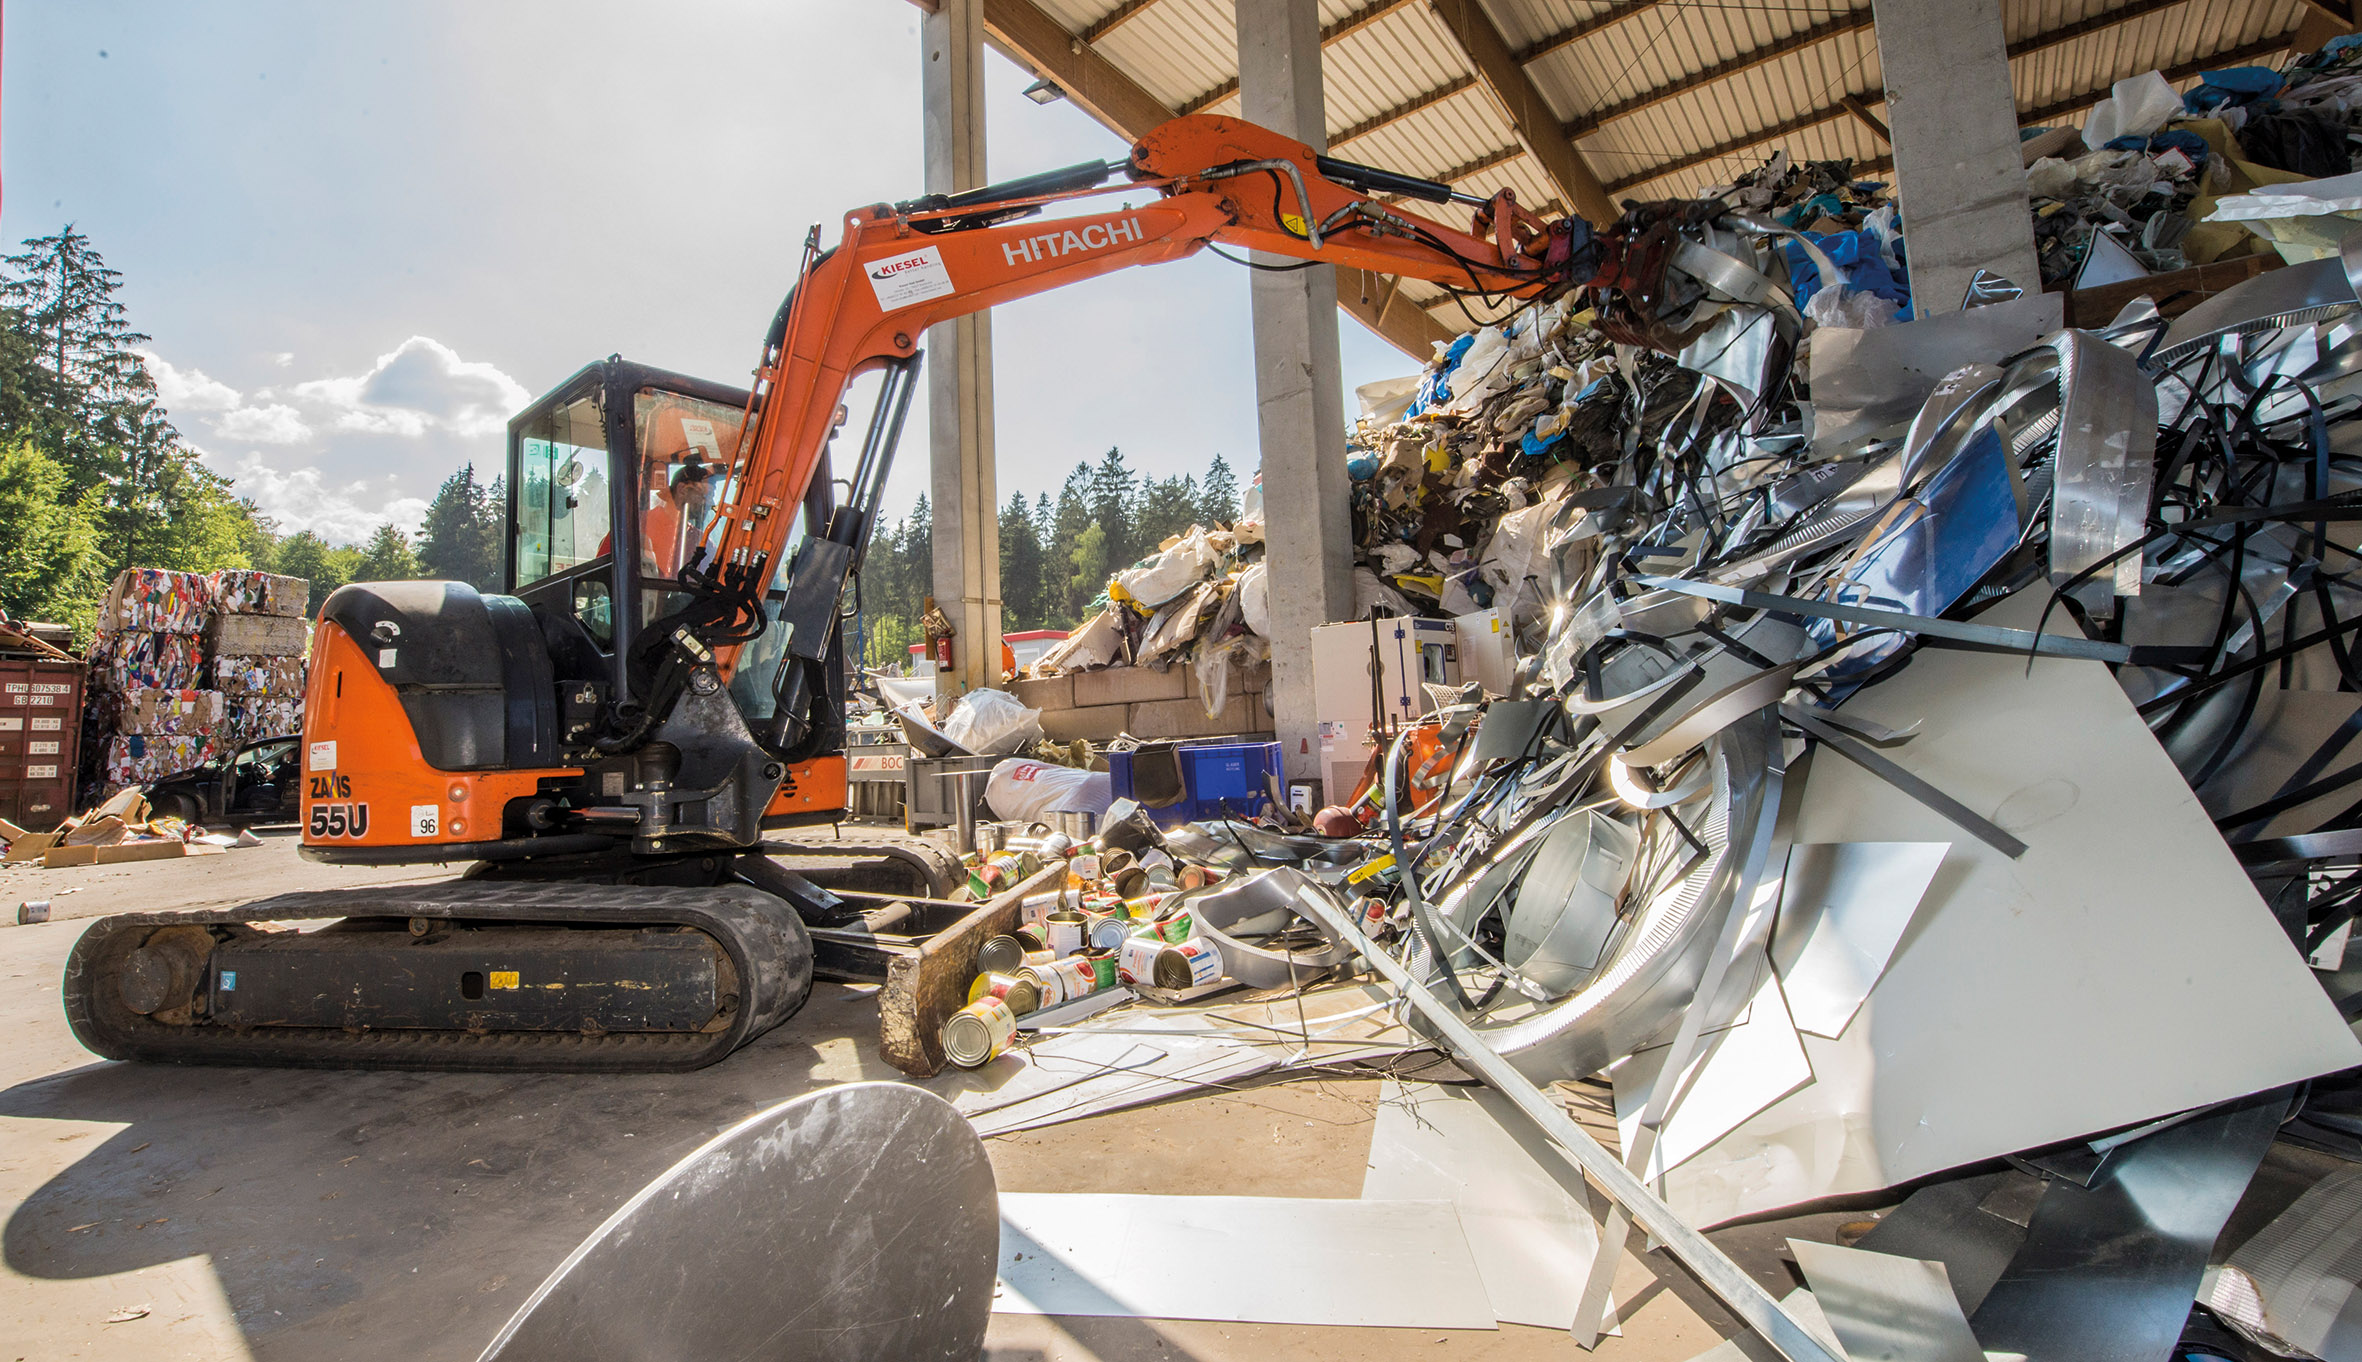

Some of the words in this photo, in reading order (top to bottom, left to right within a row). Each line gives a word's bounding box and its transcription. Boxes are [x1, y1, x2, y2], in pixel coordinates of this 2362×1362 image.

[1001, 217, 1144, 266] HITACHI
[881, 256, 929, 275] KIESEL
[30, 697, 53, 705] 2210
[881, 756, 902, 769] BOC
[310, 771, 351, 799] ZAXIS
[310, 803, 368, 837] 55U
[420, 818, 436, 834] 96
